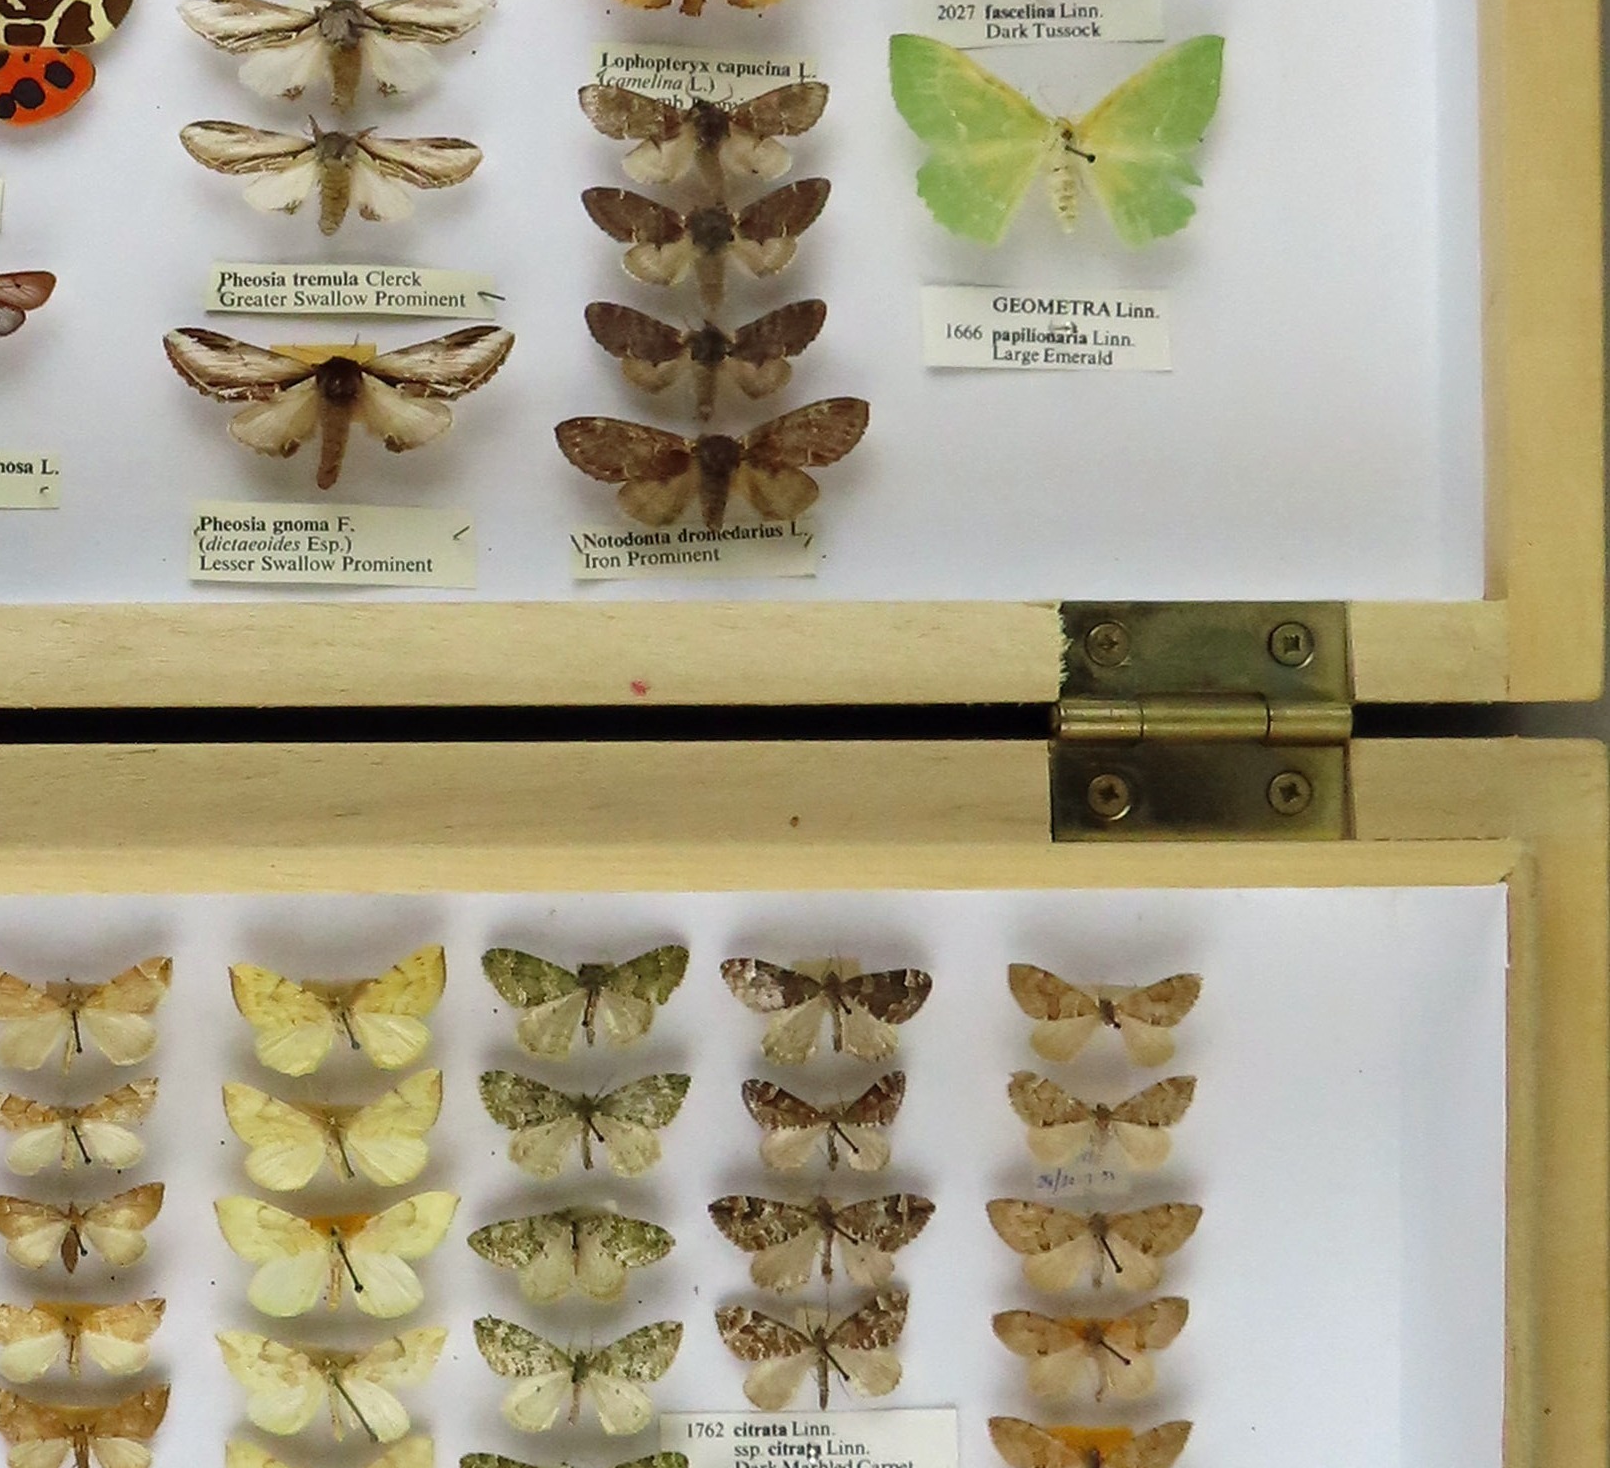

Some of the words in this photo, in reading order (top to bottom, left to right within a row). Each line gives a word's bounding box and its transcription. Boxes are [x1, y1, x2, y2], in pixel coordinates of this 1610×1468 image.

[937, 4, 975, 21] 2027
[984, 3, 1056, 20] fascelina
[1060, 3, 1103, 19] Linn.
[986, 23, 1028, 39] Dark
[1032, 21, 1102, 38] Tussock
[600, 52, 709, 74] Lophopteryx
[716, 61, 790, 80] capucina
[220, 271, 286, 287] Pheosia
[293, 271, 358, 287] tremula
[365, 271, 422, 287] Clerck
[219, 291, 287, 308] Greater
[293, 290, 368, 307] Swallow
[375, 291, 466, 308] Prominent
[992, 296, 1111, 317] GEOMETRA
[1116, 301, 1160, 319] Linn.
[945, 322, 983, 340] 1666
[992, 344, 1040, 365] Large
[1043, 347, 1113, 366] Emerald
[40, 458, 60, 476] L.
[199, 515, 266, 532] Pheosia
[272, 518, 329, 535] gnoma
[336, 516, 355, 532] F.
[198, 535, 300, 552] (dictaeoides
[307, 535, 353, 555] Esp.)
[199, 555, 255, 572] Lesser
[261, 555, 335, 572] Swallow
[342, 555, 433, 573] Prominent
[583, 552, 621, 569] Iron
[627, 547, 720, 566] Prominent
[687, 1421, 725, 1438] 1762
[733, 1420, 788, 1437] citrata
